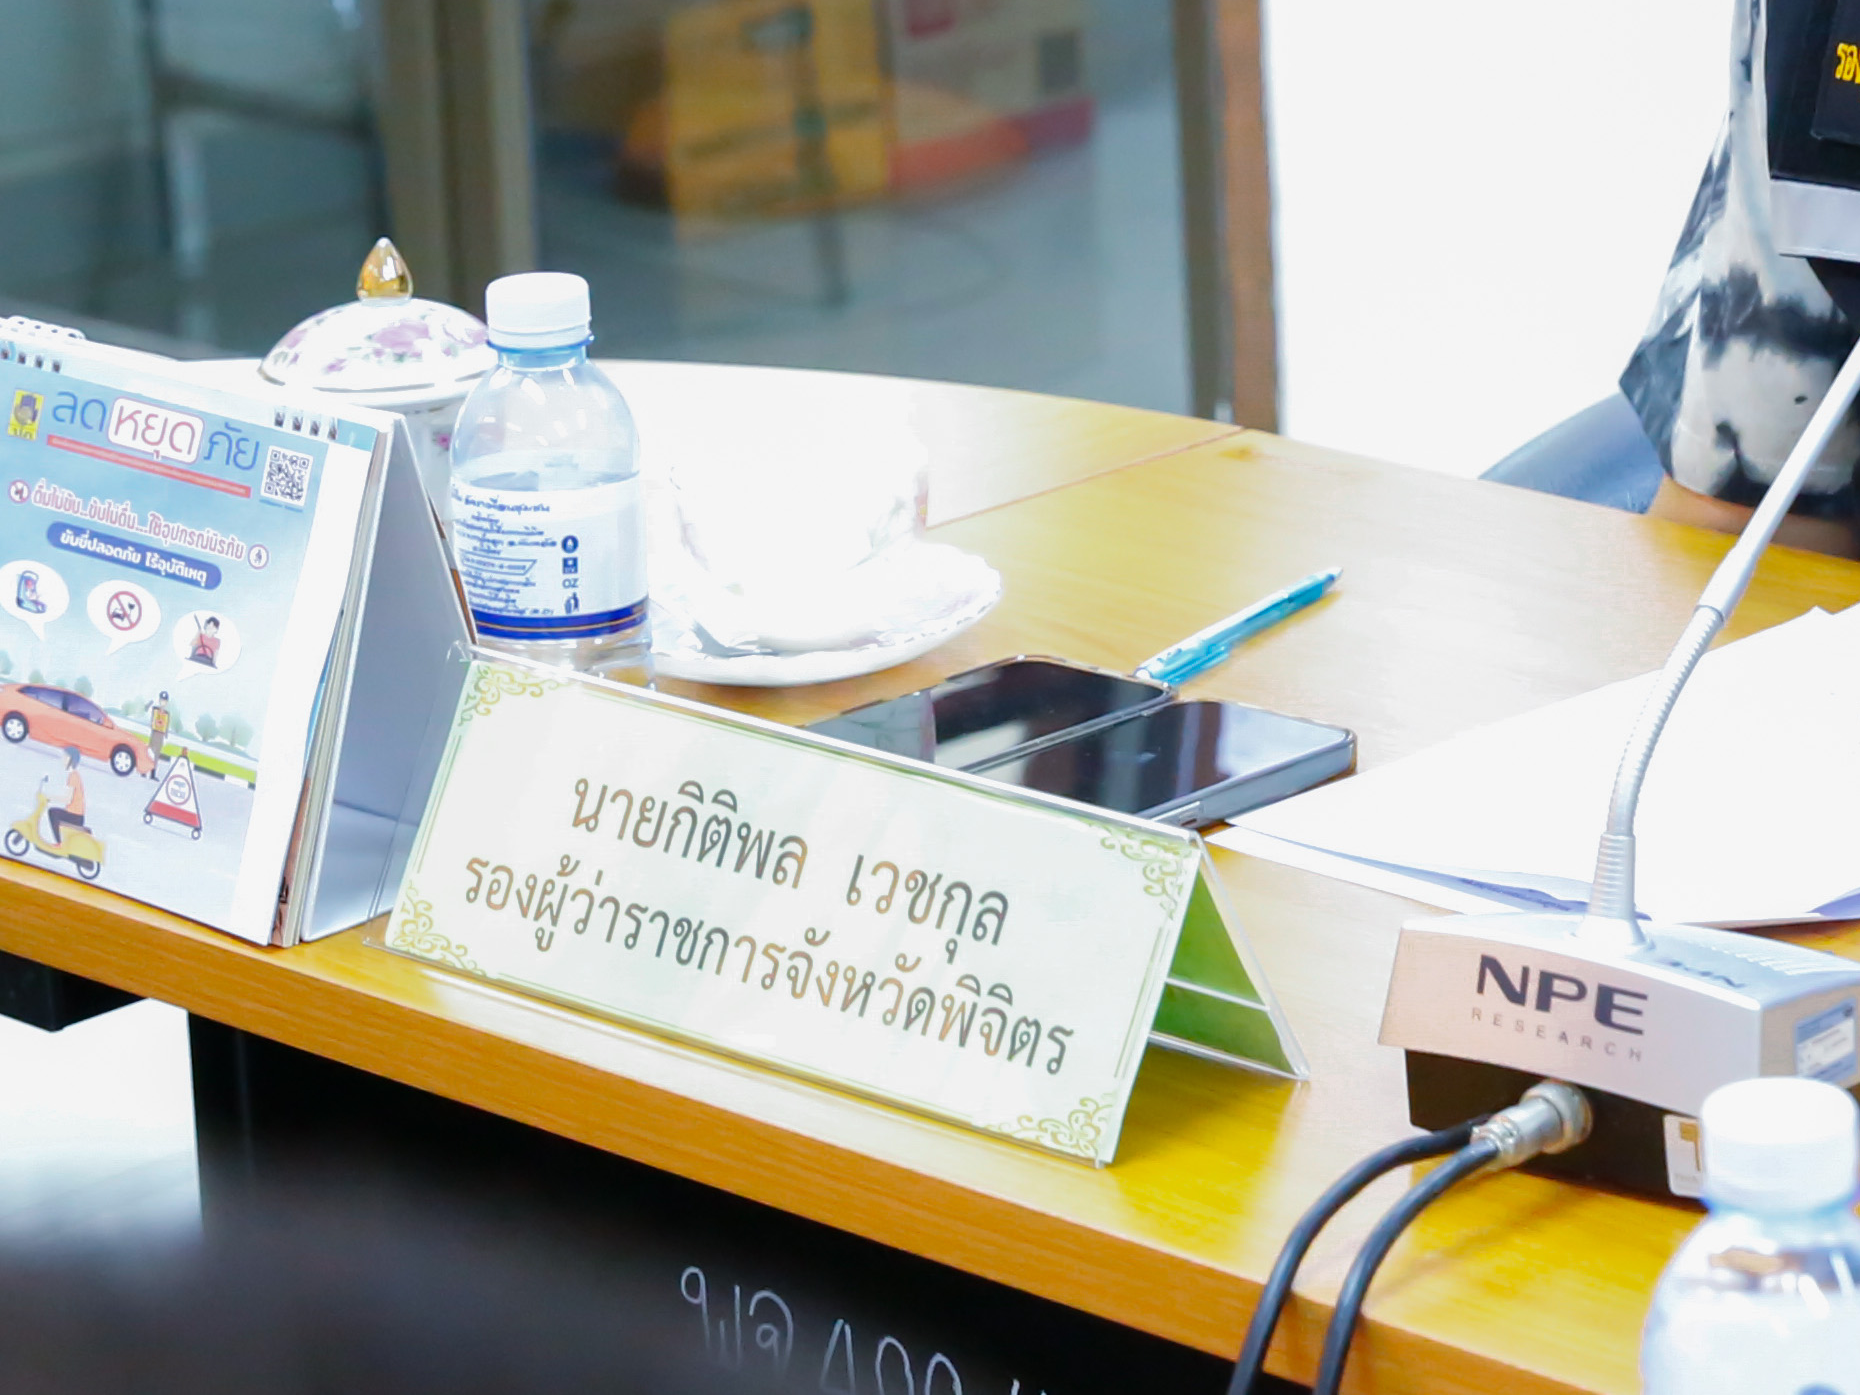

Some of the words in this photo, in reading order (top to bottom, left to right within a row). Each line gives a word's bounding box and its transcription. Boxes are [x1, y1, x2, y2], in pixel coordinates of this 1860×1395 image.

[571, 779, 808, 889] นายกิติพล
[846, 854, 1010, 964] เวชกุล
[465, 853, 1075, 1075] รองผู้ว่าราชการจังหวัดพิจิตร
[1476, 954, 1648, 1035] NPE
[1471, 1007, 1642, 1062] RESEARCH
